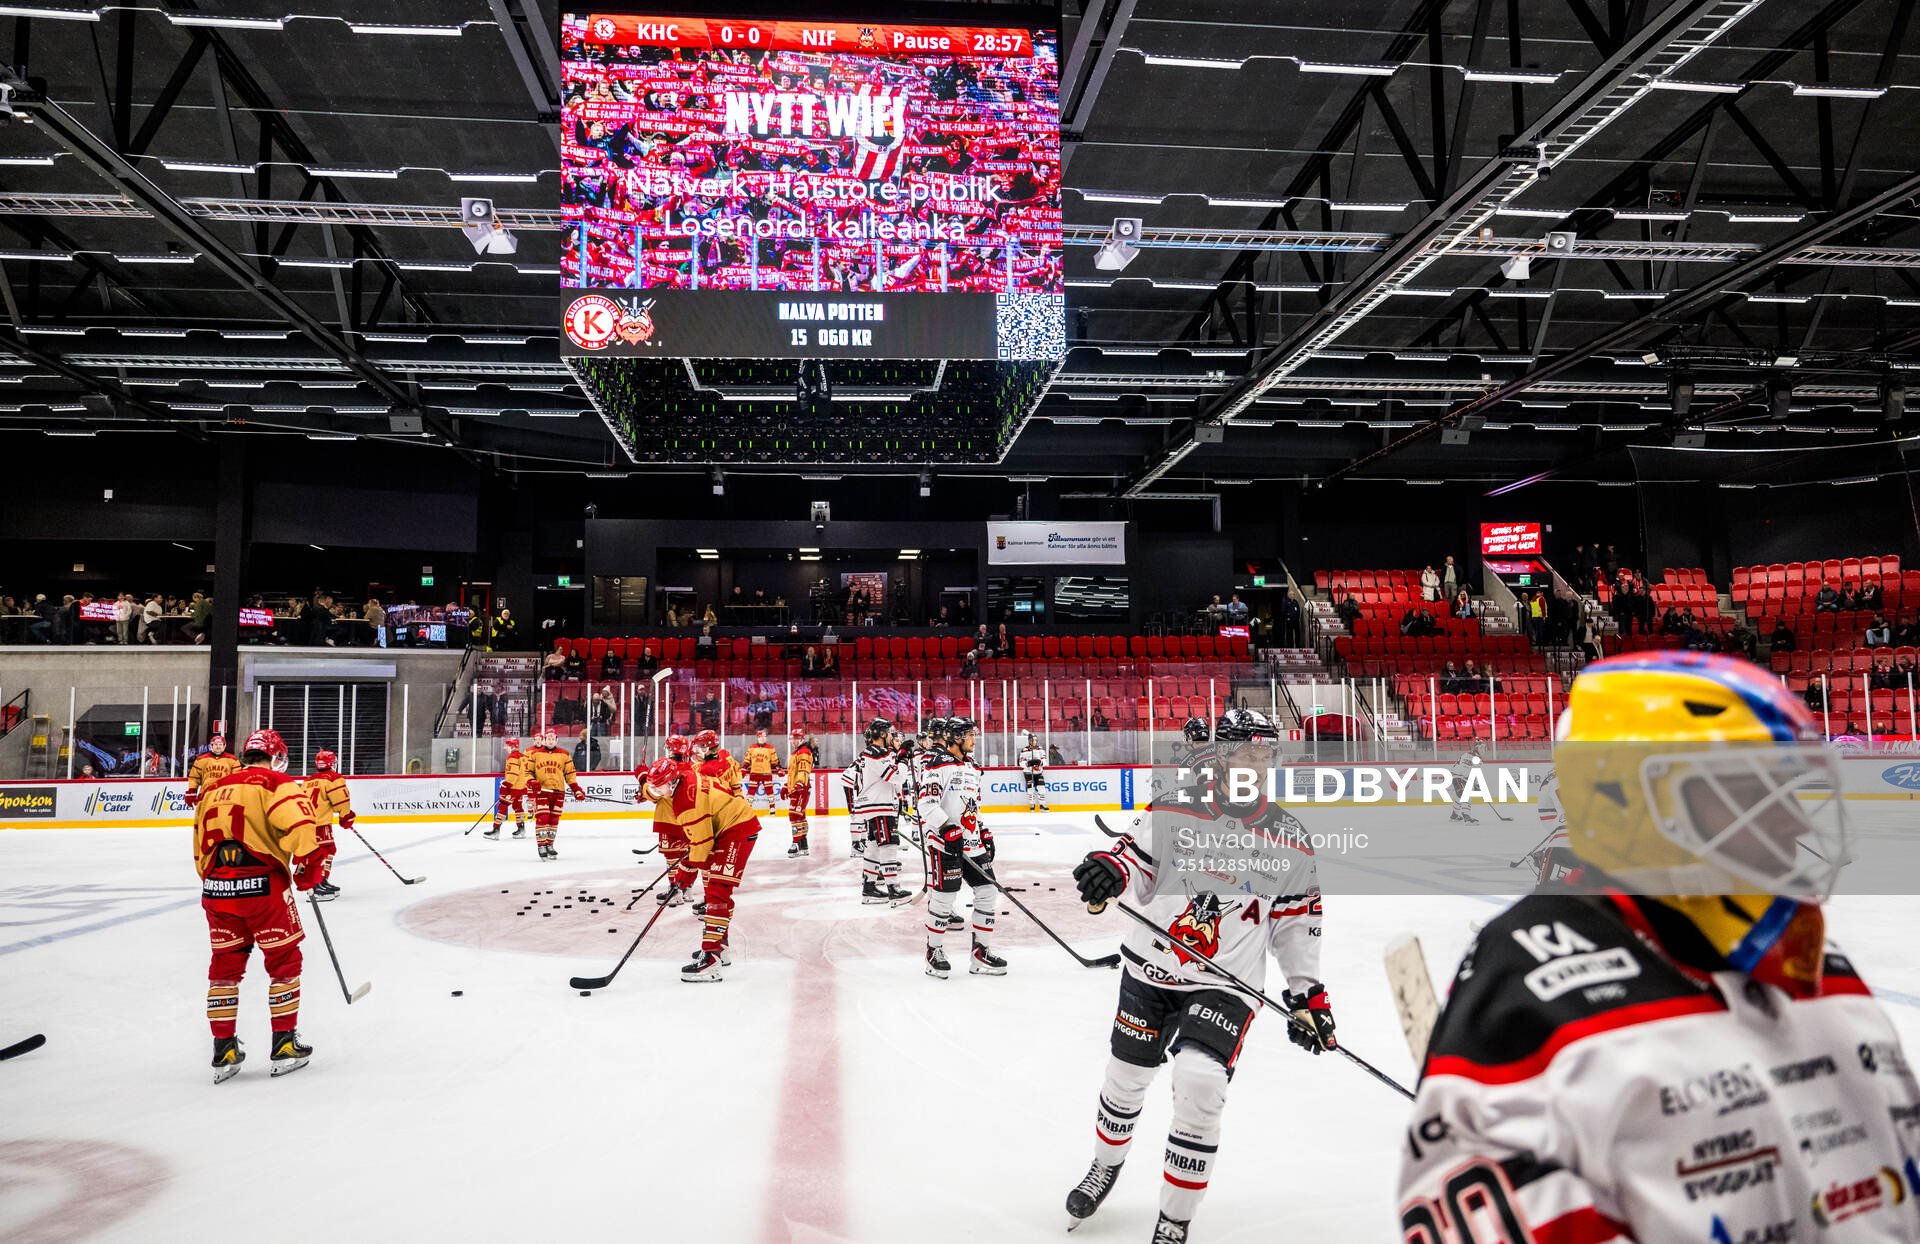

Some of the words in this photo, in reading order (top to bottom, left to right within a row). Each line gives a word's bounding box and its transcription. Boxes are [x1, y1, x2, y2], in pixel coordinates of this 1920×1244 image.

[638, 23, 679, 41] KHC
[721, 26, 733, 43] 0
[748, 28, 760, 44] 0
[803, 29, 837, 46] NIF
[893, 31, 950, 50] Pause
[974, 35, 1023, 51] 28:57
[726, 91, 816, 136] NYTT
[825, 94, 905, 137] WIFI
[770, 172, 1001, 208] Hatstore-publik
[665, 208, 816, 238] Lösenord:
[827, 211, 965, 241] kalleanka
[779, 303, 825, 320] HALVA
[828, 304, 884, 321] POTTEN
[584, 310, 605, 335] K
[791, 328, 808, 346] 15
[818, 329, 849, 346] 060
[852, 329, 873, 346] KR
[1048, 532, 1091, 543] Tillsammans
[439, 789, 481, 799] ÖLANDS
[587, 784, 612, 795] RÖR
[1074, 781, 1107, 792] BYGG
[99, 791, 134, 802] Svensk
[372, 800, 464, 811] VATTENSKÄRNING
[466, 800, 481, 809] AB
[103, 802, 131, 812] Cater
[297, 801, 317, 817] 61
[201, 804, 245, 855] 61
[1240, 898, 1261, 926] A
[1120, 1009, 1148, 1028] NYBRO
[1200, 1005, 1239, 1037] Bitus
[1114, 1021, 1154, 1043] BYGGPLÅT
